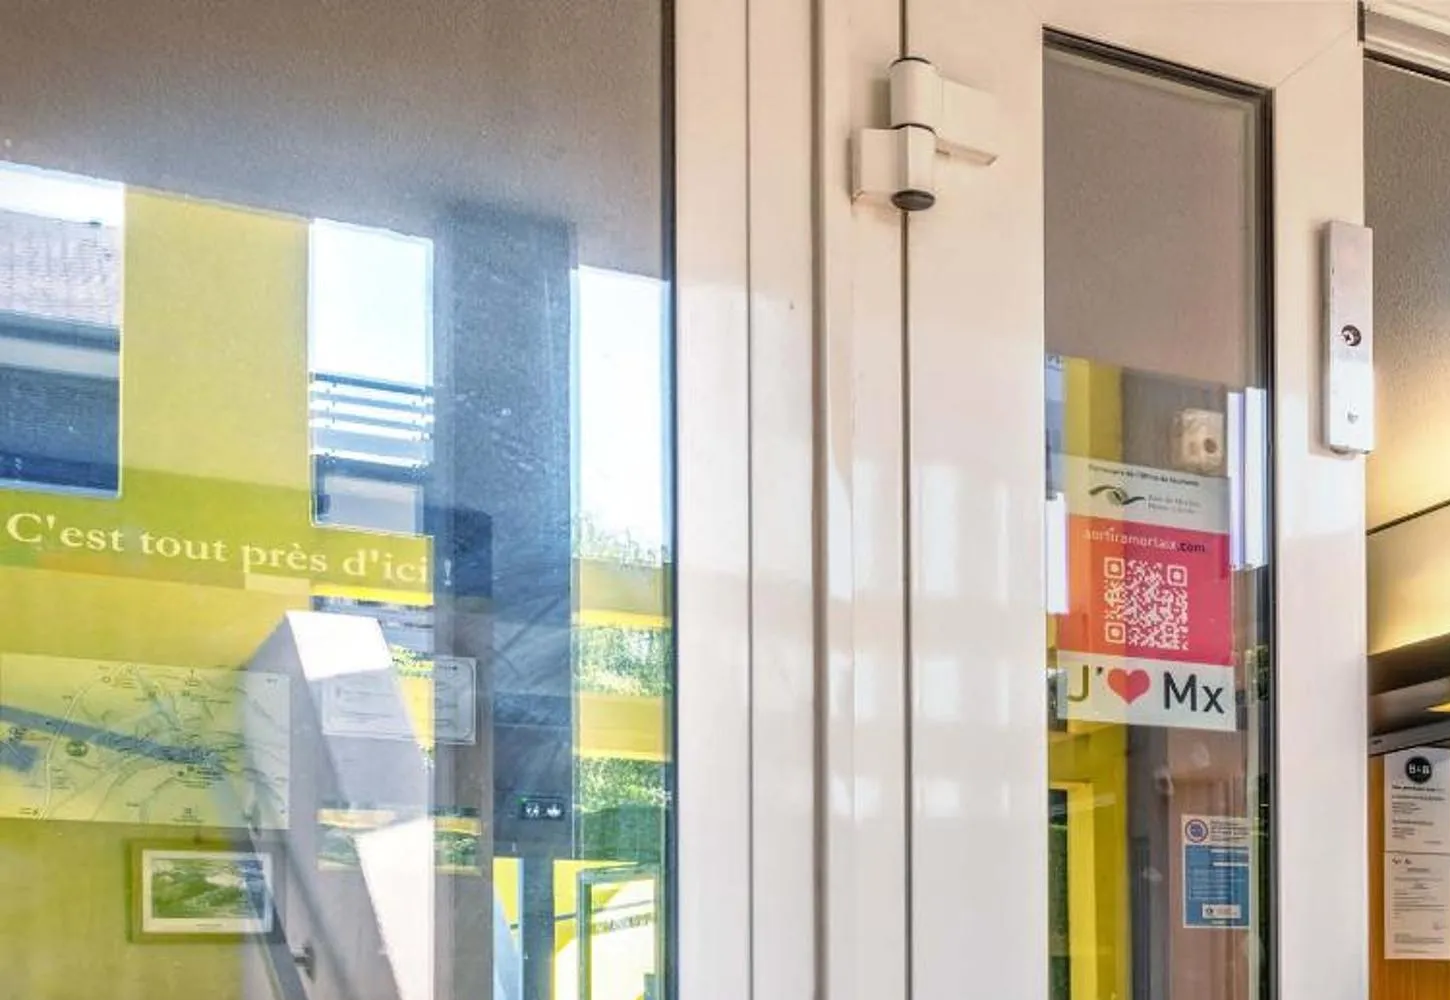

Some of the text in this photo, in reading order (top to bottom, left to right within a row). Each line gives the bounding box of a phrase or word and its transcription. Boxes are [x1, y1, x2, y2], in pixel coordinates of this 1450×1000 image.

[6, 512, 124, 552] C'est
[140, 528, 228, 562] tout
[243, 543, 327, 573] près
[343, 549, 429, 583] d'ici
[1164, 671, 1225, 713] Mx
